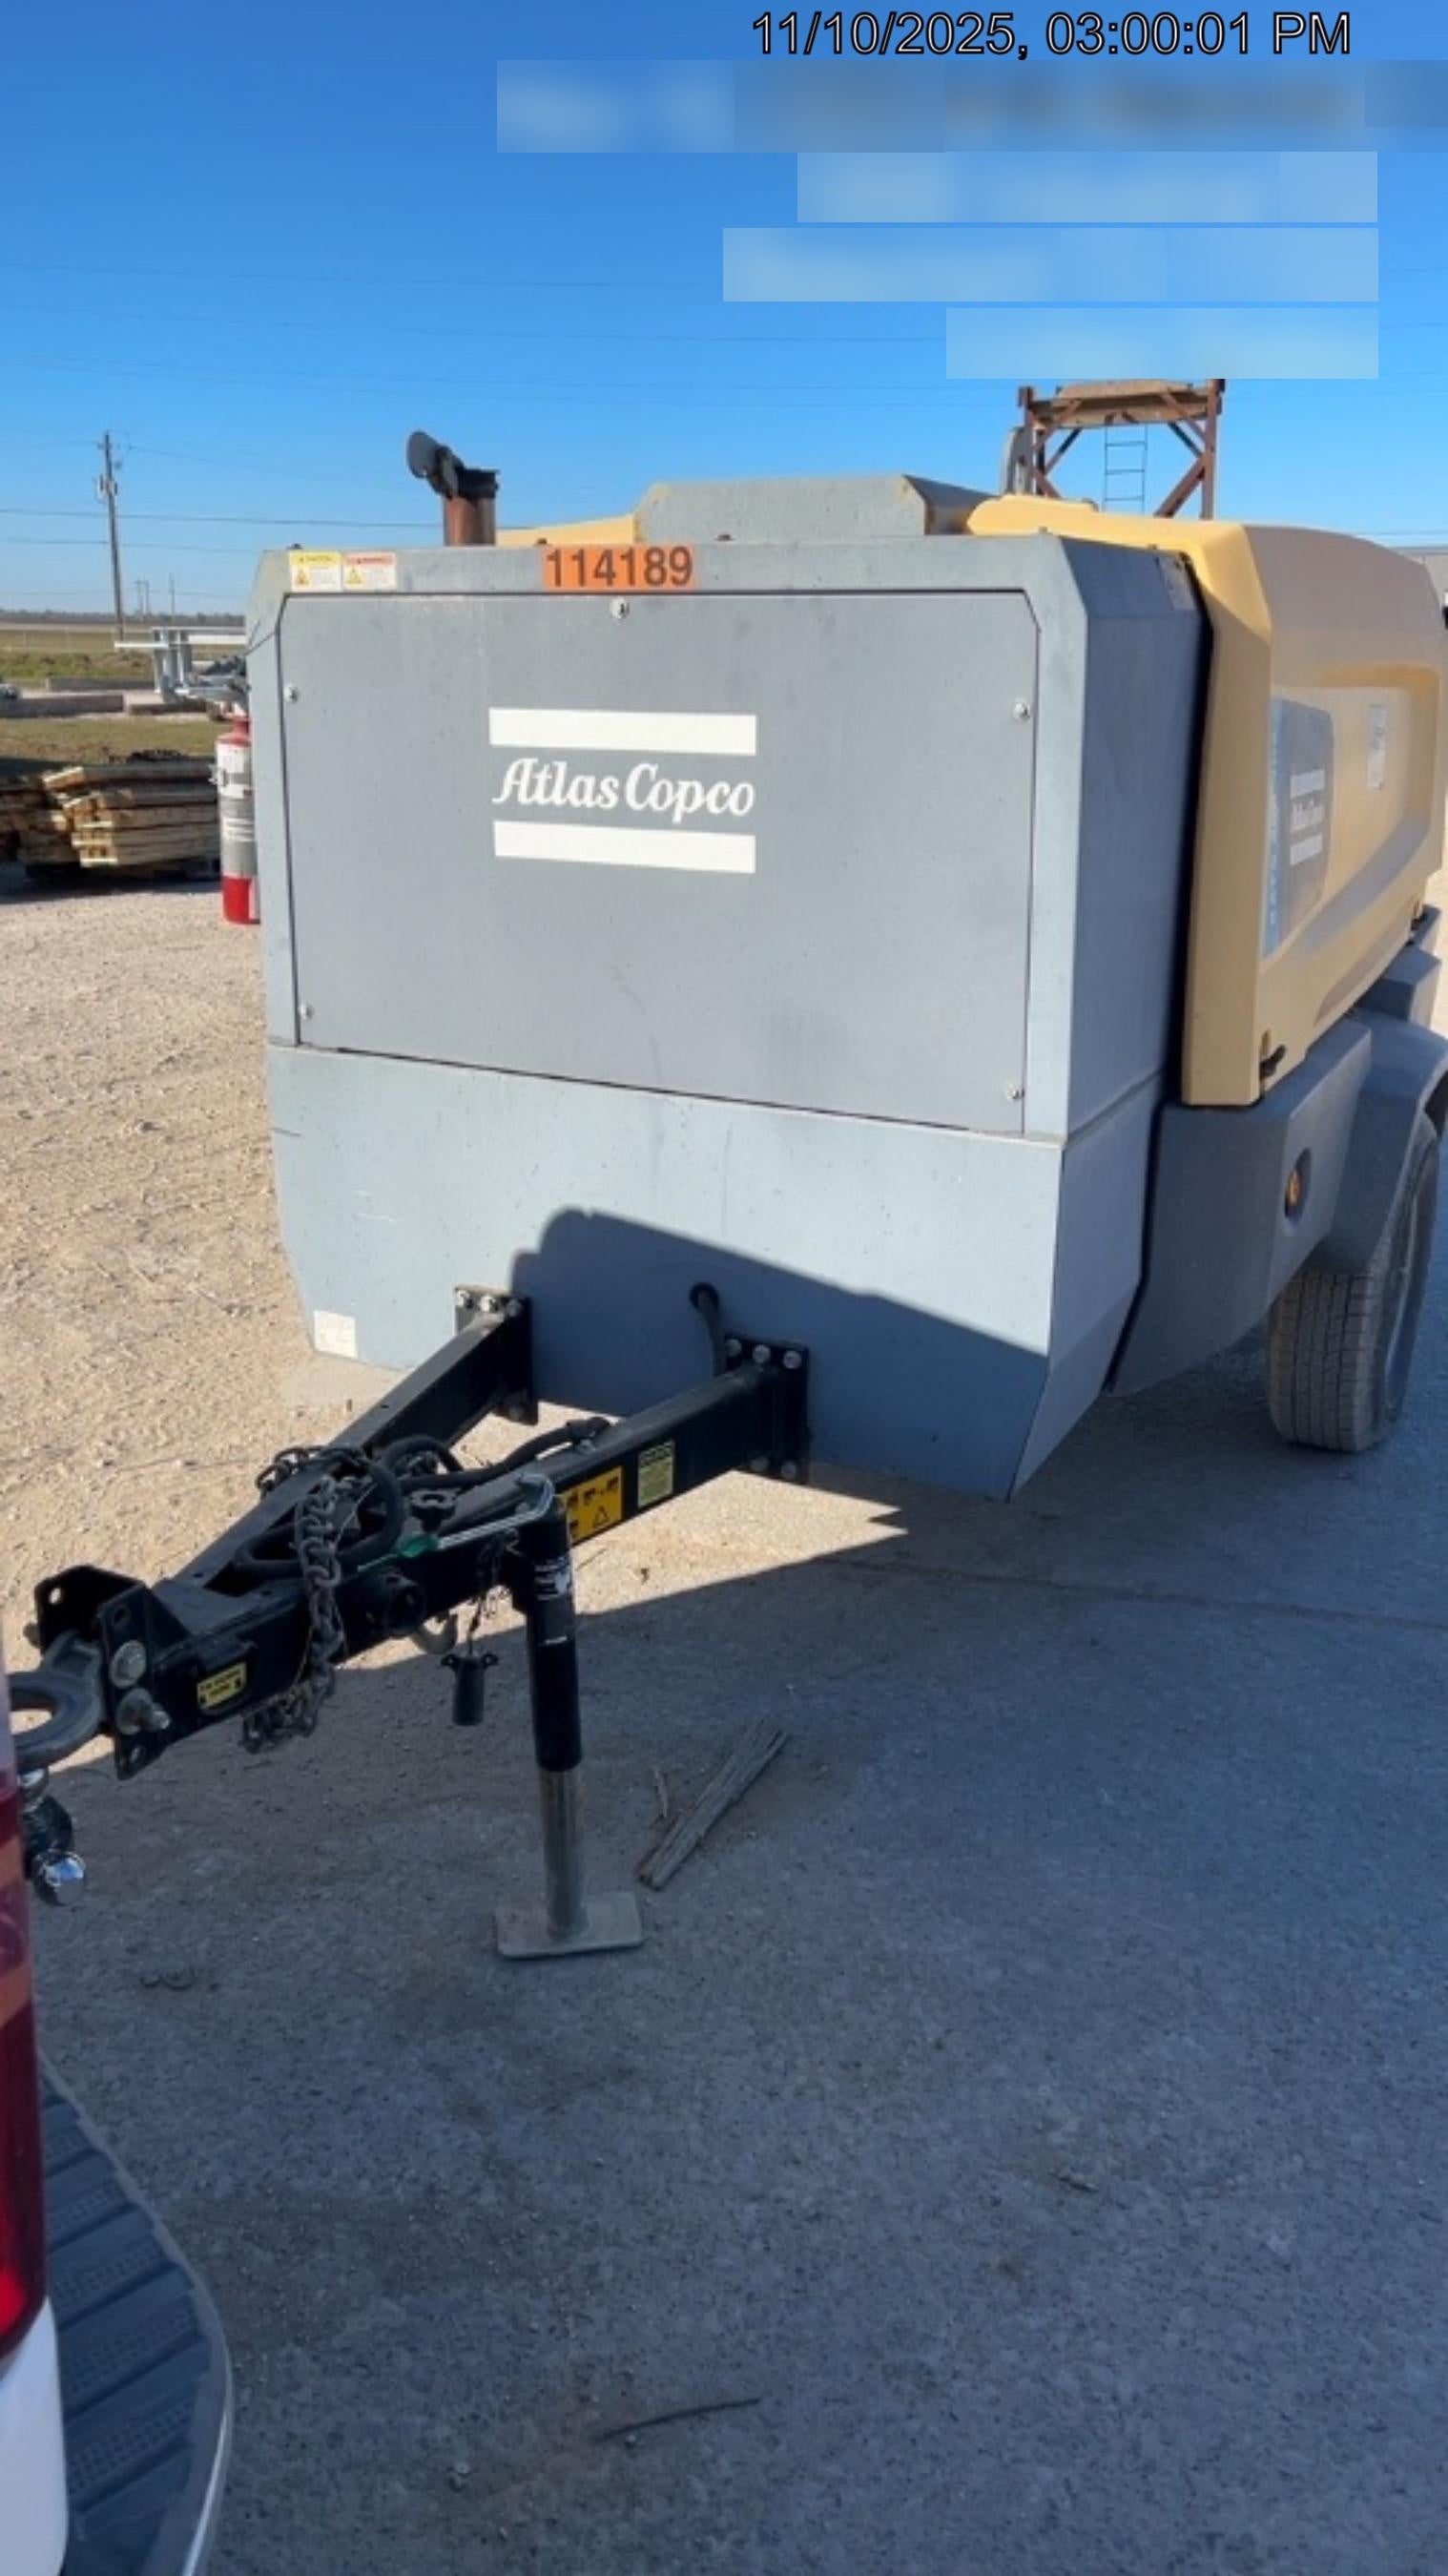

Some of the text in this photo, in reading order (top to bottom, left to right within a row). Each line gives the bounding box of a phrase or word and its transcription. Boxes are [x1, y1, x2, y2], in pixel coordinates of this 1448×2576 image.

[547, 546, 693, 588] 114189
[491, 758, 755, 824] Atlas Copco
